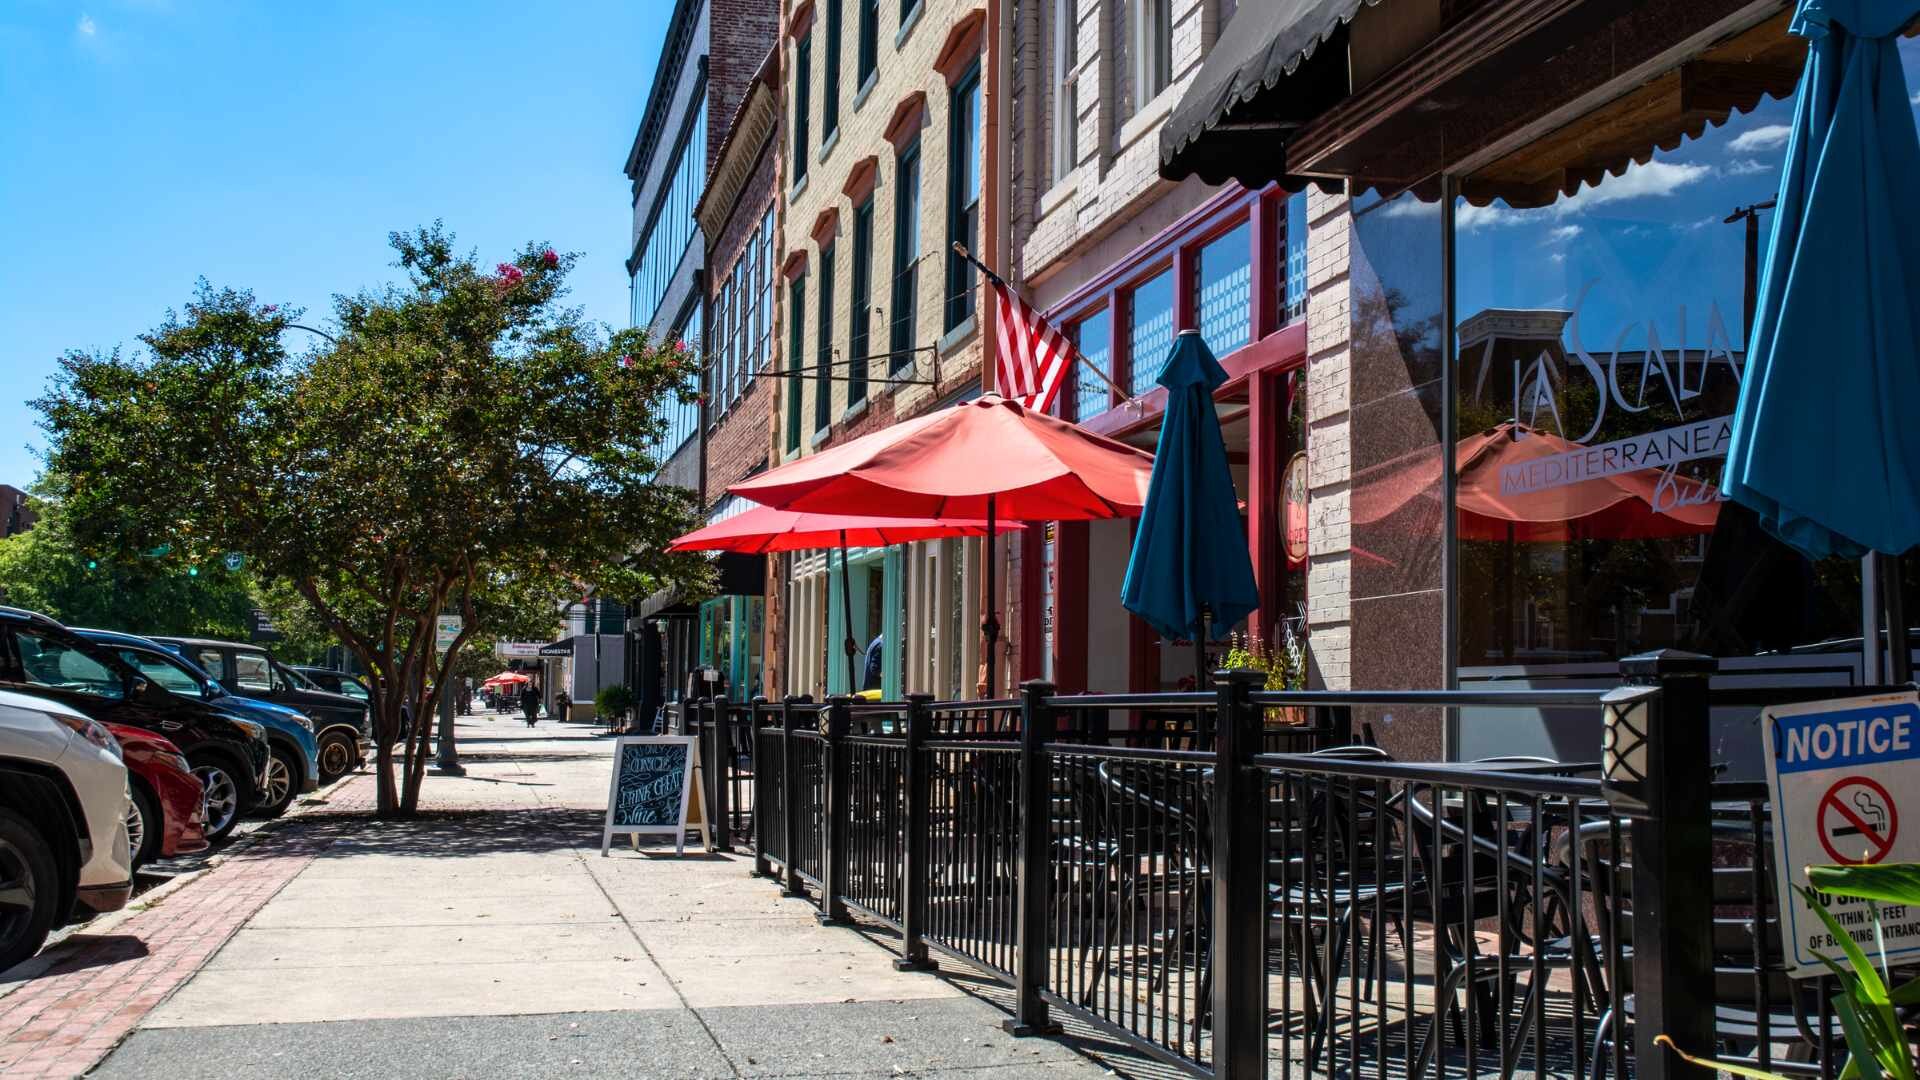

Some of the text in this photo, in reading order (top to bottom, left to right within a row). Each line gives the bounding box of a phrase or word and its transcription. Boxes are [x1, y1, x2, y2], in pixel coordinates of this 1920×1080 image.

[1503, 423, 1731, 491] MEDITERRANEA
[1786, 714, 1912, 763] NOTICE
[1882, 905, 1906, 920] FEET
[1809, 935, 1823, 949] OF
